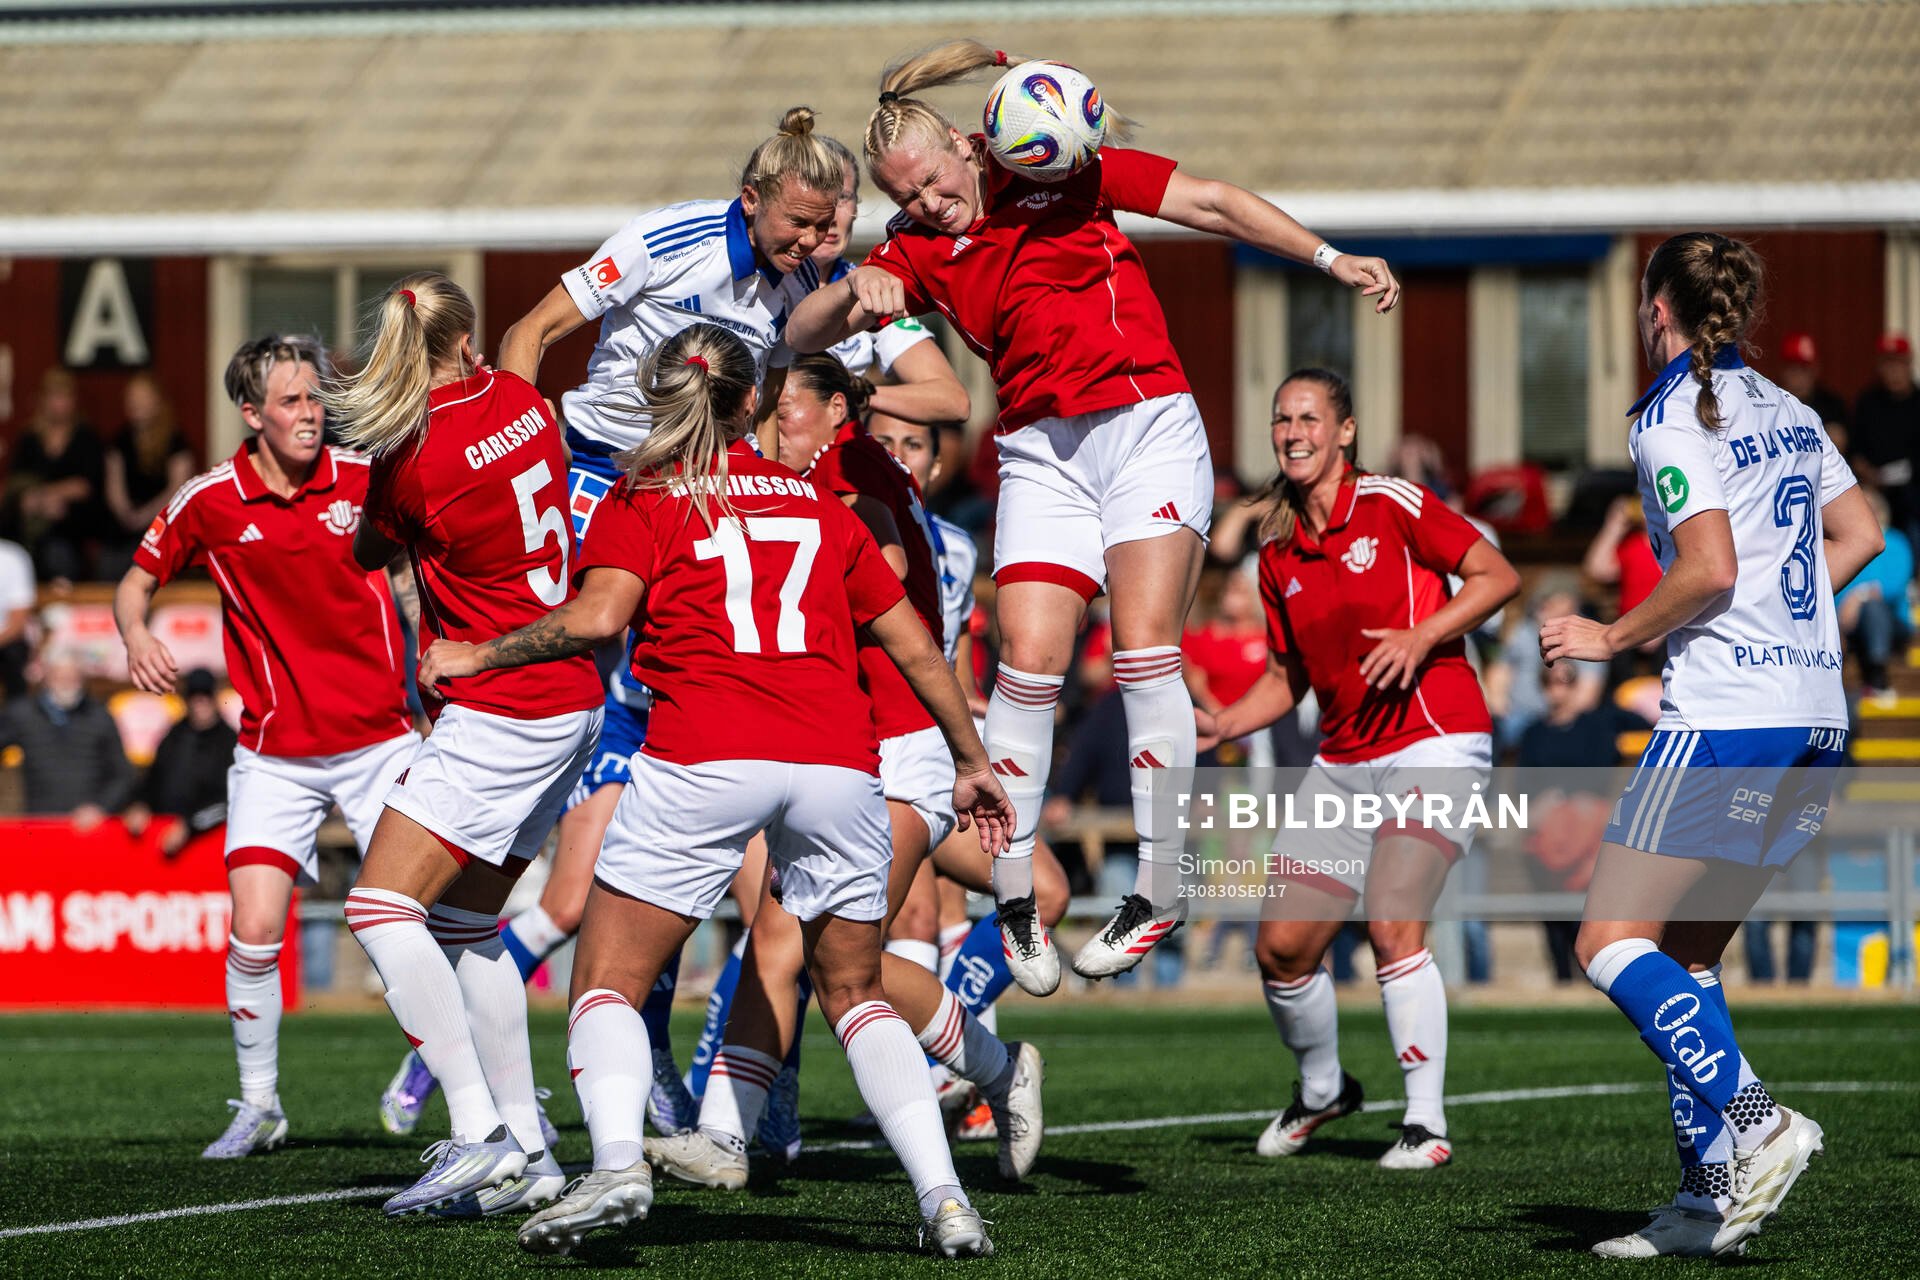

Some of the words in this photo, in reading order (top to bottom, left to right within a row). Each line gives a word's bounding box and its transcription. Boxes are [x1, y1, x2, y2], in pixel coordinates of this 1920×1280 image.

[578, 267, 594, 290] ENSKA
[65, 258, 149, 366] A
[464, 406, 547, 470] CARLSSON
[1730, 435, 1761, 468] DE
[1759, 430, 1781, 459] LA
[510, 458, 570, 607] 5
[1774, 474, 1817, 621] 3
[693, 516, 821, 653] 17
[1727, 805, 1767, 825] zer
[1732, 788, 1773, 807] pre
[1801, 803, 1828, 817] pr
[1796, 818, 1821, 836] ze
[958, 954, 994, 1006] cab
[1654, 993, 1726, 1083] Ocab
